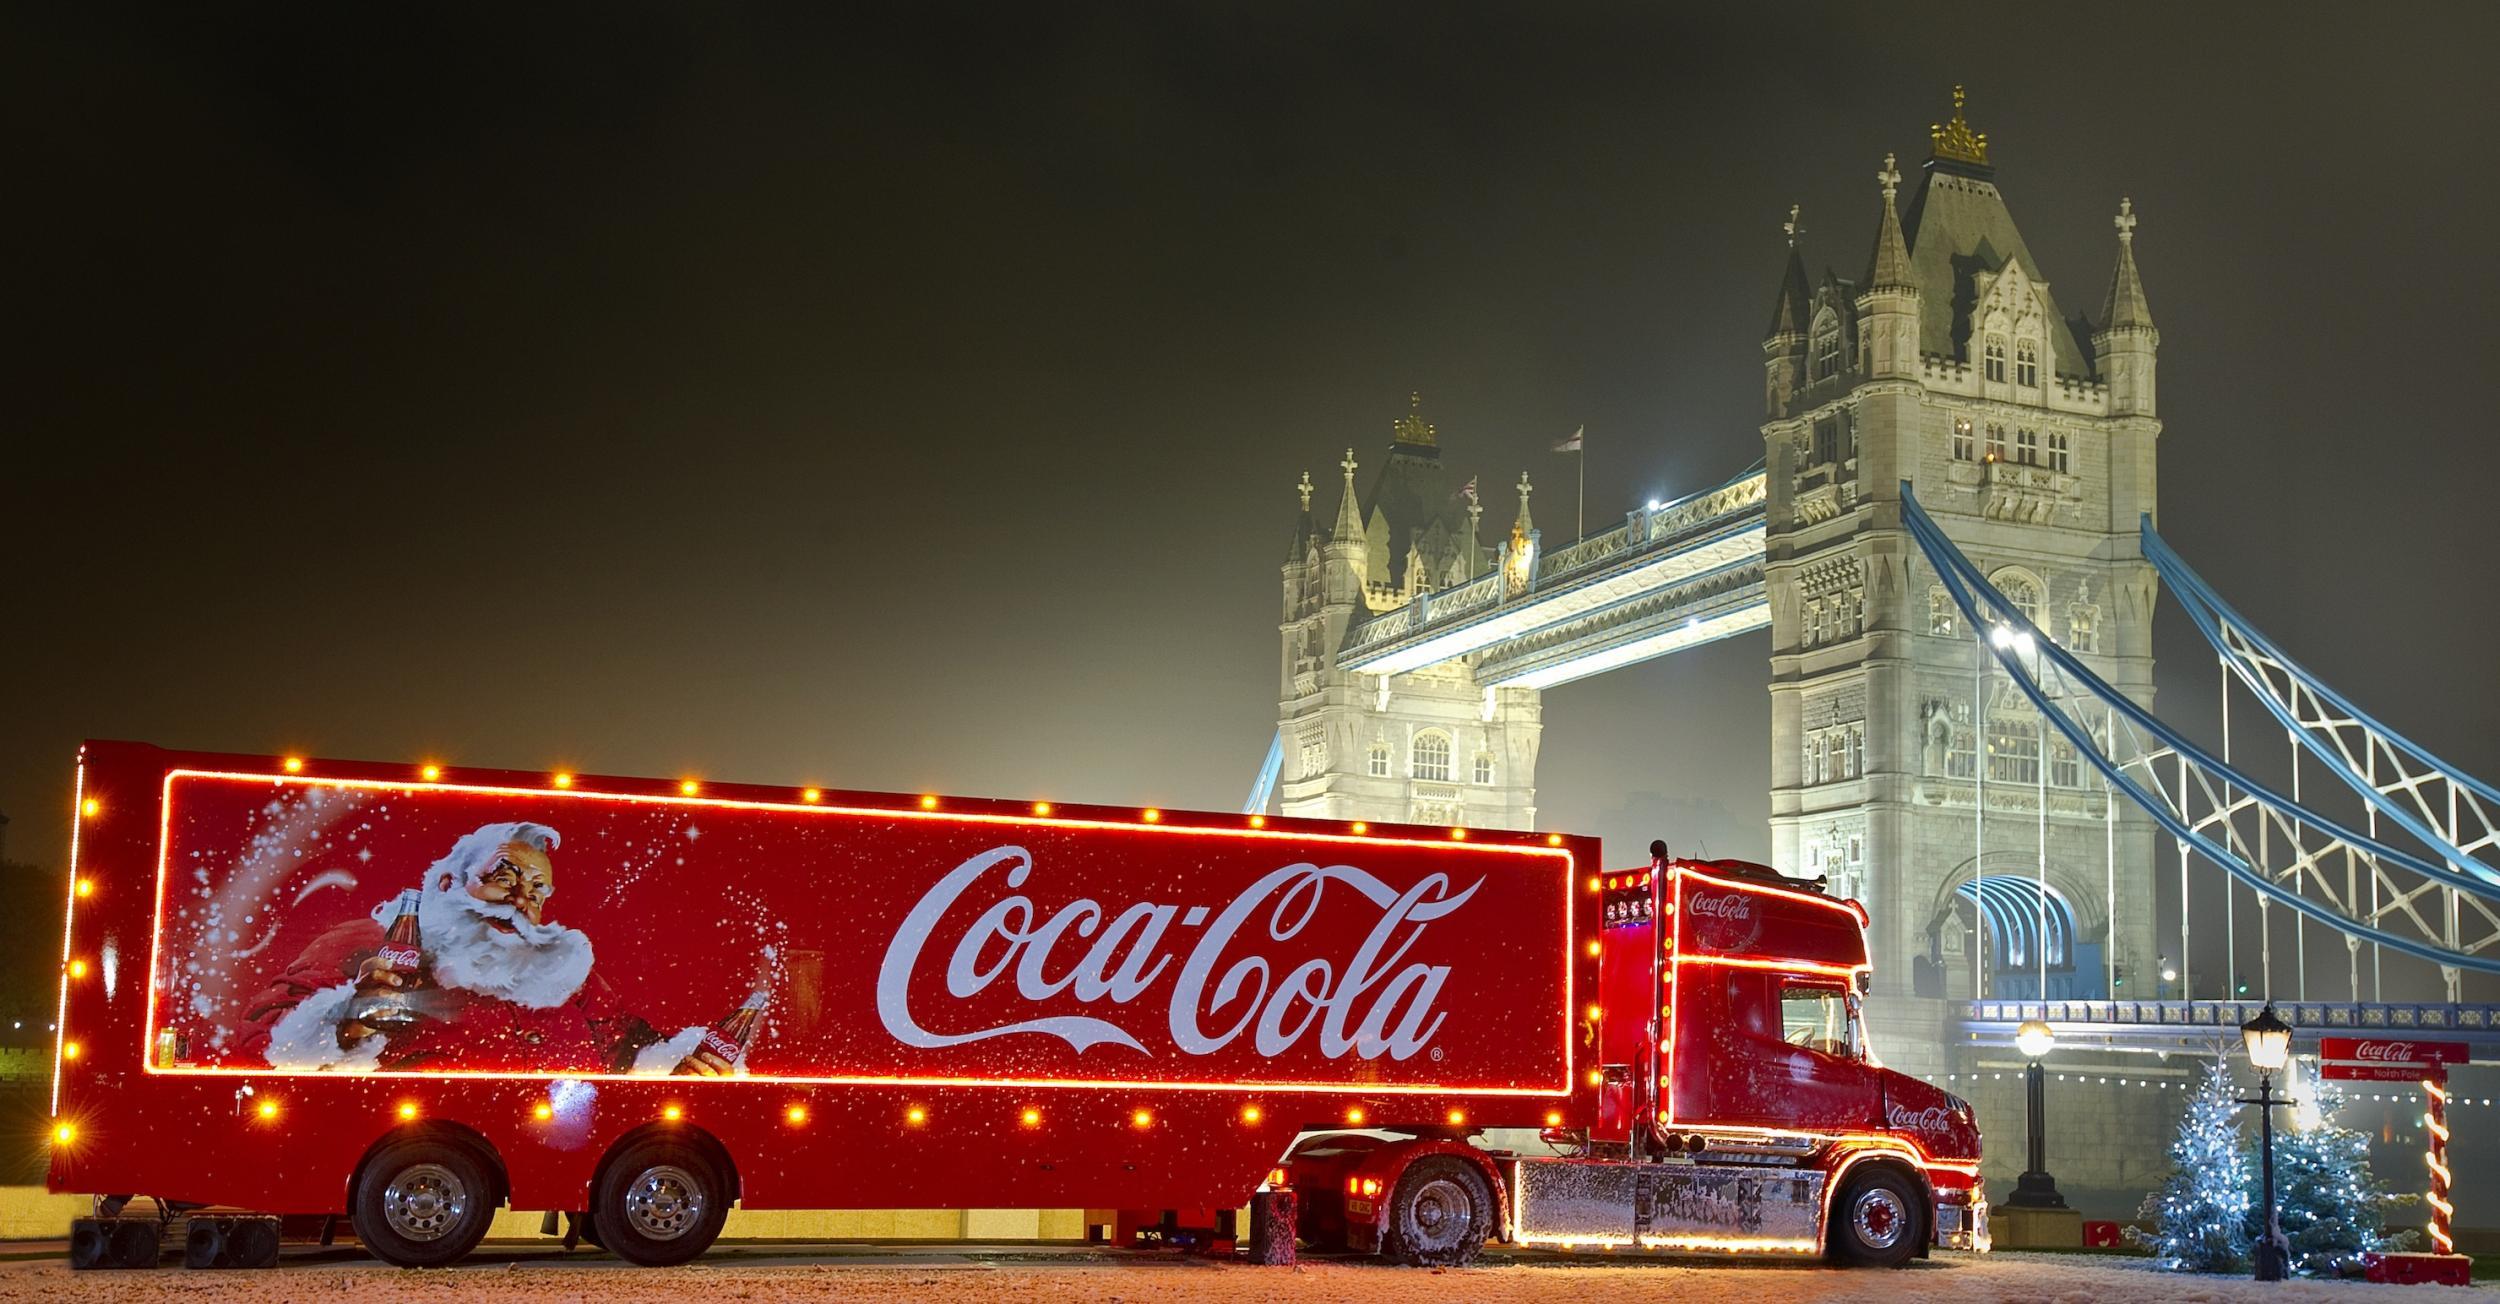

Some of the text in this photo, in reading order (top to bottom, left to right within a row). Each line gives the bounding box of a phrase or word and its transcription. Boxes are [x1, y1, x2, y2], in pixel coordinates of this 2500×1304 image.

[1689, 891, 1752, 919] Coca-Cola
[876, 845, 1487, 1061] Coca-Cola
[2355, 1041, 2415, 1061] Coca-Cola
[2374, 1069, 2421, 1079] North Pole
[1889, 1104, 1950, 1131] Coca-Cola
